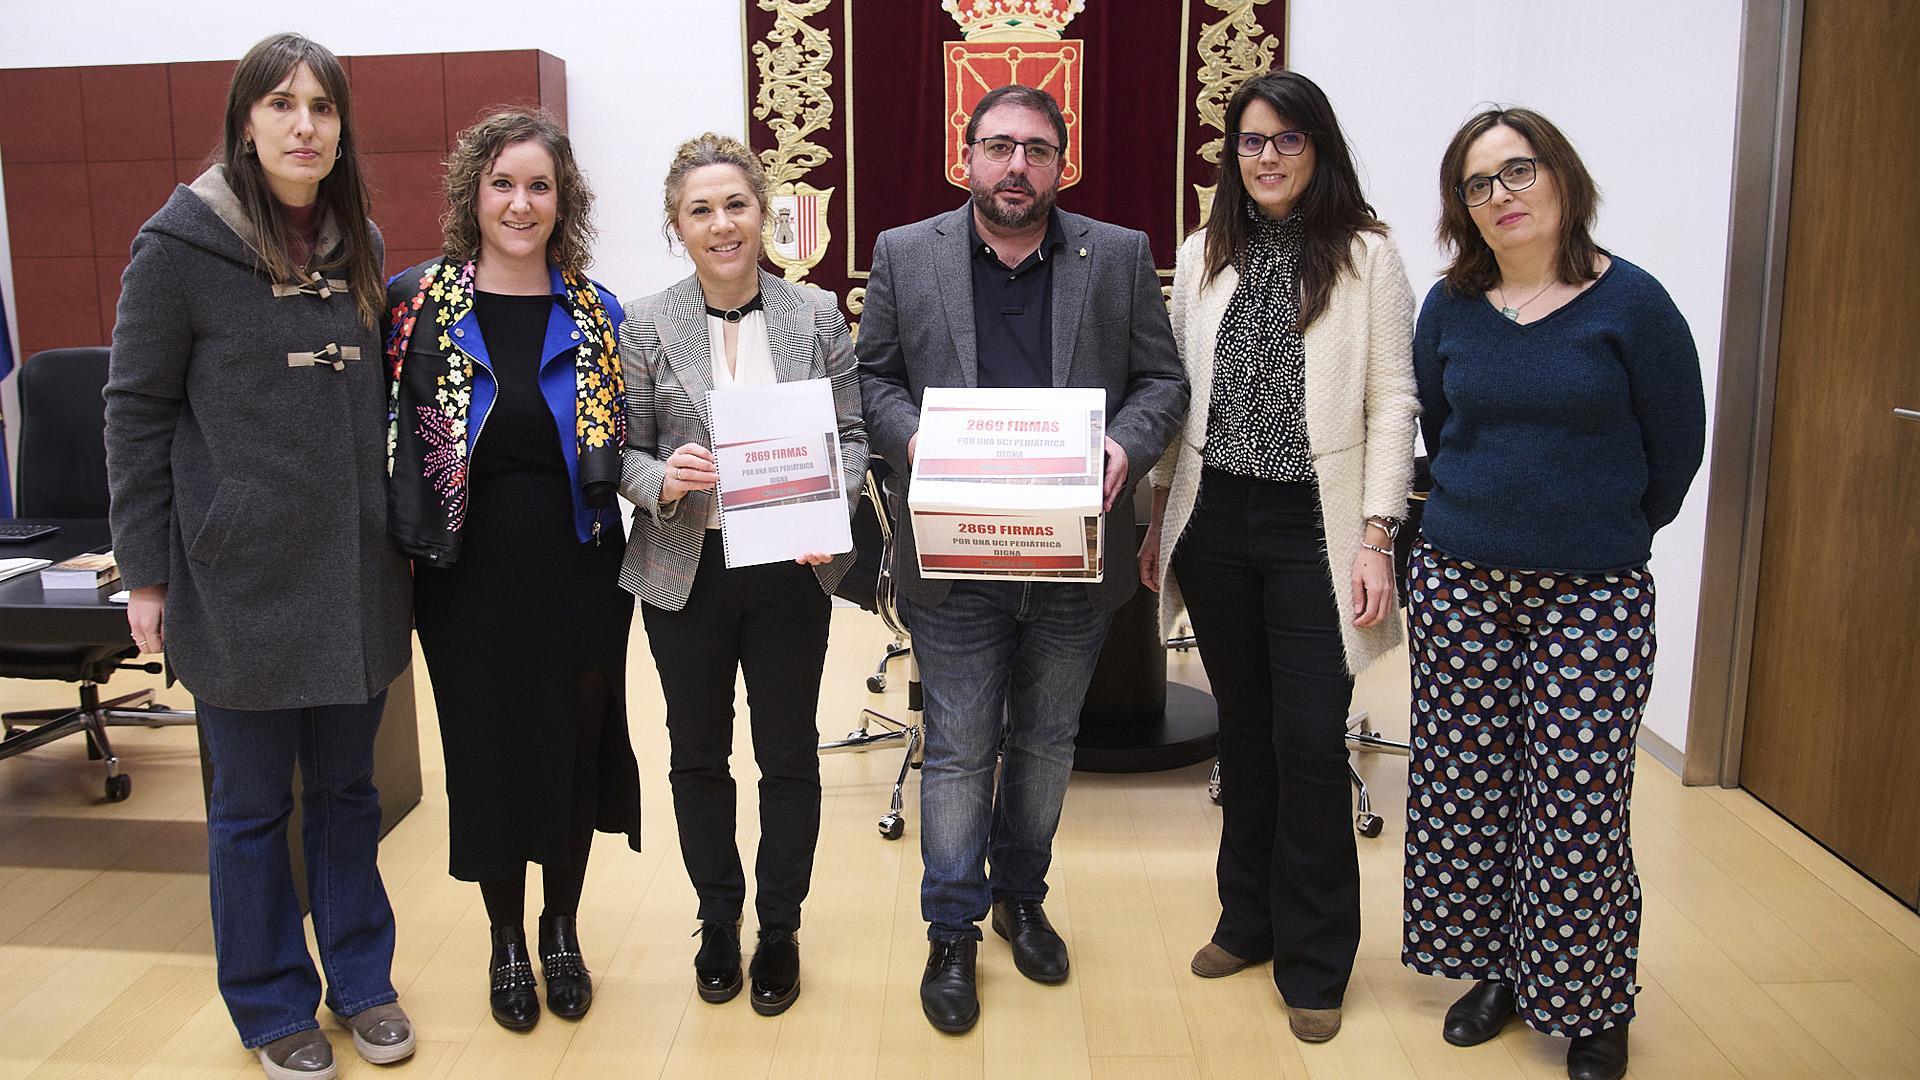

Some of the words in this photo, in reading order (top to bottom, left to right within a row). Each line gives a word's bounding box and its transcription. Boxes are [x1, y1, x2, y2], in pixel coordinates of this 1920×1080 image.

[966, 419, 1004, 432] 2869
[1007, 420, 1060, 433] FIRMAS
[745, 450, 770, 463] 2869
[772, 446, 808, 460] FIRMAS
[958, 523, 997, 535] 2869
[999, 525, 1054, 536] FIRMAS
[952, 537, 971, 545] POR
[972, 538, 991, 546] UNA
[992, 539, 1008, 547] UCI
[993, 549, 1022, 557] DIGNA
